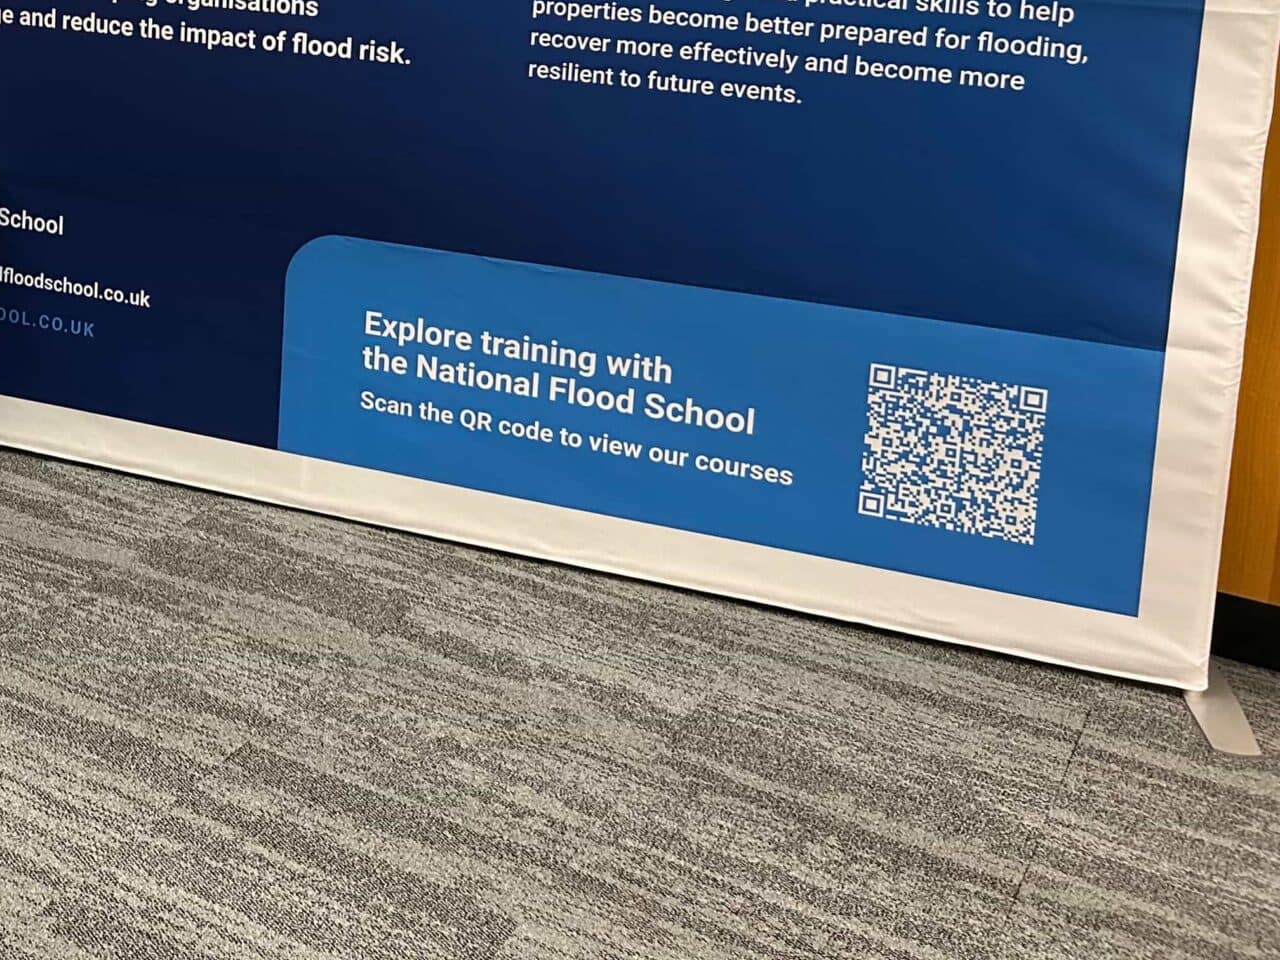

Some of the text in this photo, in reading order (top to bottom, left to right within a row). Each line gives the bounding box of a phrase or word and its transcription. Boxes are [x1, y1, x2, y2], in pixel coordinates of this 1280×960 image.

[20, 9, 56, 28] and
[63, 12, 133, 36] reduce
[140, 18, 173, 40] the
[181, 22, 256, 49] impact
[263, 31, 286, 51] of
[292, 32, 352, 58] flood
[360, 40, 410, 64] risk.
[533, 0, 1087, 64] properties become better prepared for flooding,
[987, 0, 1011, 17] to
[1020, 0, 1074, 27] help
[529, 63, 801, 103] resilient to future events.
[531, 32, 1024, 90] recover more effectively and become more
[365, 311, 671, 384] Explore training with
[363, 346, 754, 434] the National Flood School
[361, 391, 792, 485] Scan the QR code to view our courses
